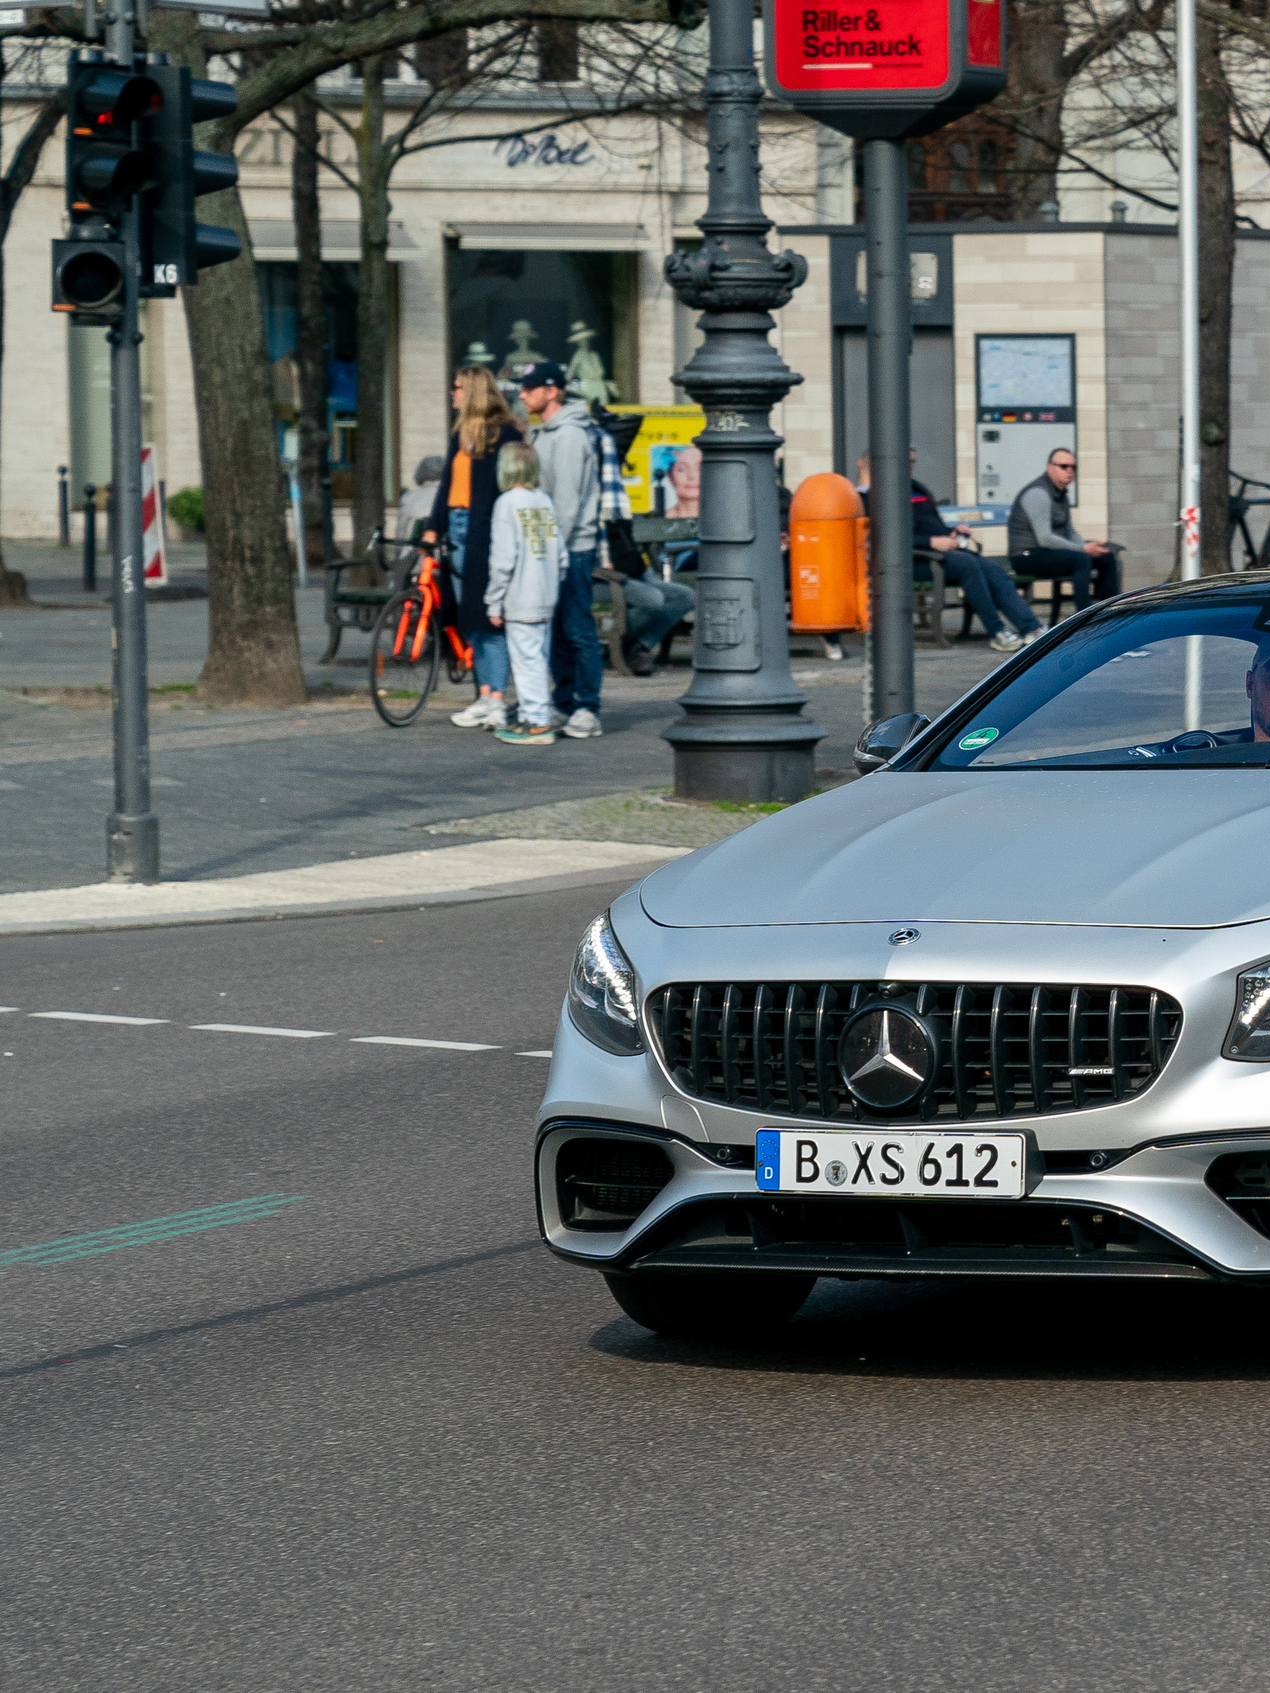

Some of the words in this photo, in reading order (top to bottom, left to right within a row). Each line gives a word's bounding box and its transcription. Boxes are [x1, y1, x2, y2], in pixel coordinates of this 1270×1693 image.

[802, 10, 862, 32] Riller
[865, 9, 882, 31] &
[803, 35, 922, 57] Schnauck
[153, 263, 178, 284] K6
[764, 1166, 774, 1179] D
[796, 1140, 820, 1183] B
[851, 1141, 905, 1185] XS
[917, 1142, 999, 1188] 612
